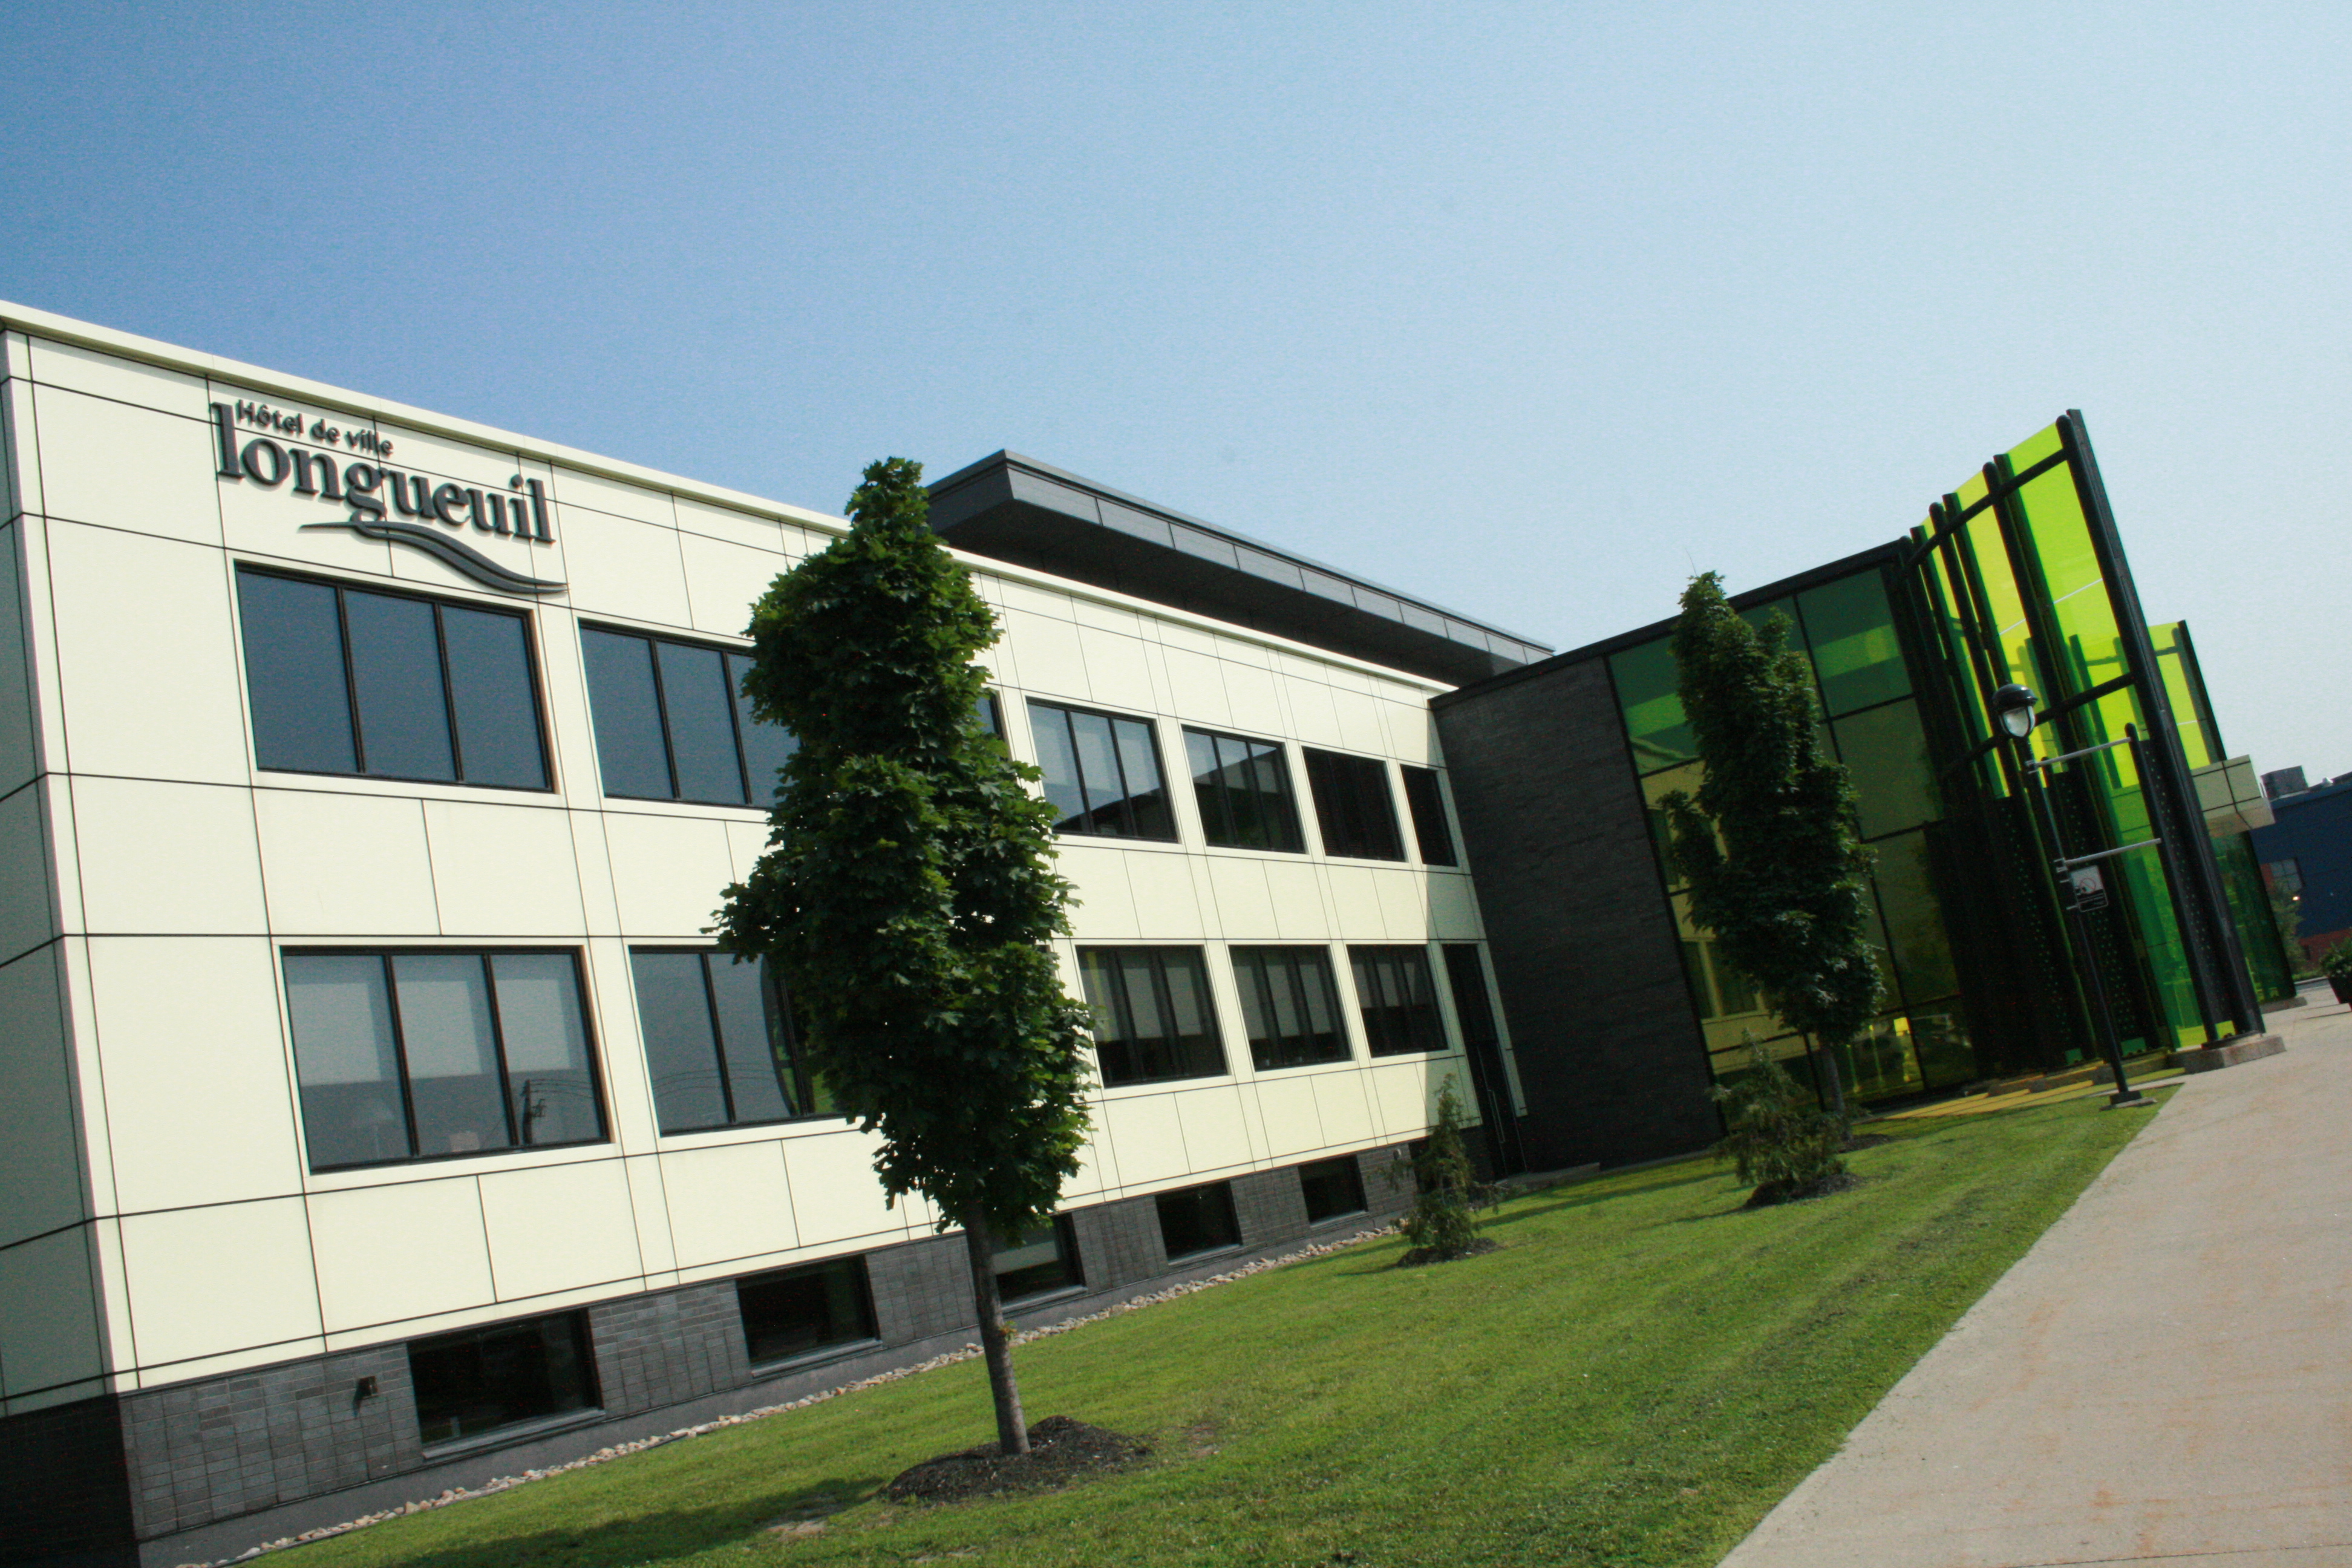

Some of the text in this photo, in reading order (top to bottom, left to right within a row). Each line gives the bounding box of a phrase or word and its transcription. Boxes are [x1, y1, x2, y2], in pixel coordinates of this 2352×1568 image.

[211, 402, 556, 544] longueuil
[238, 399, 394, 455] Hôtel de ville
